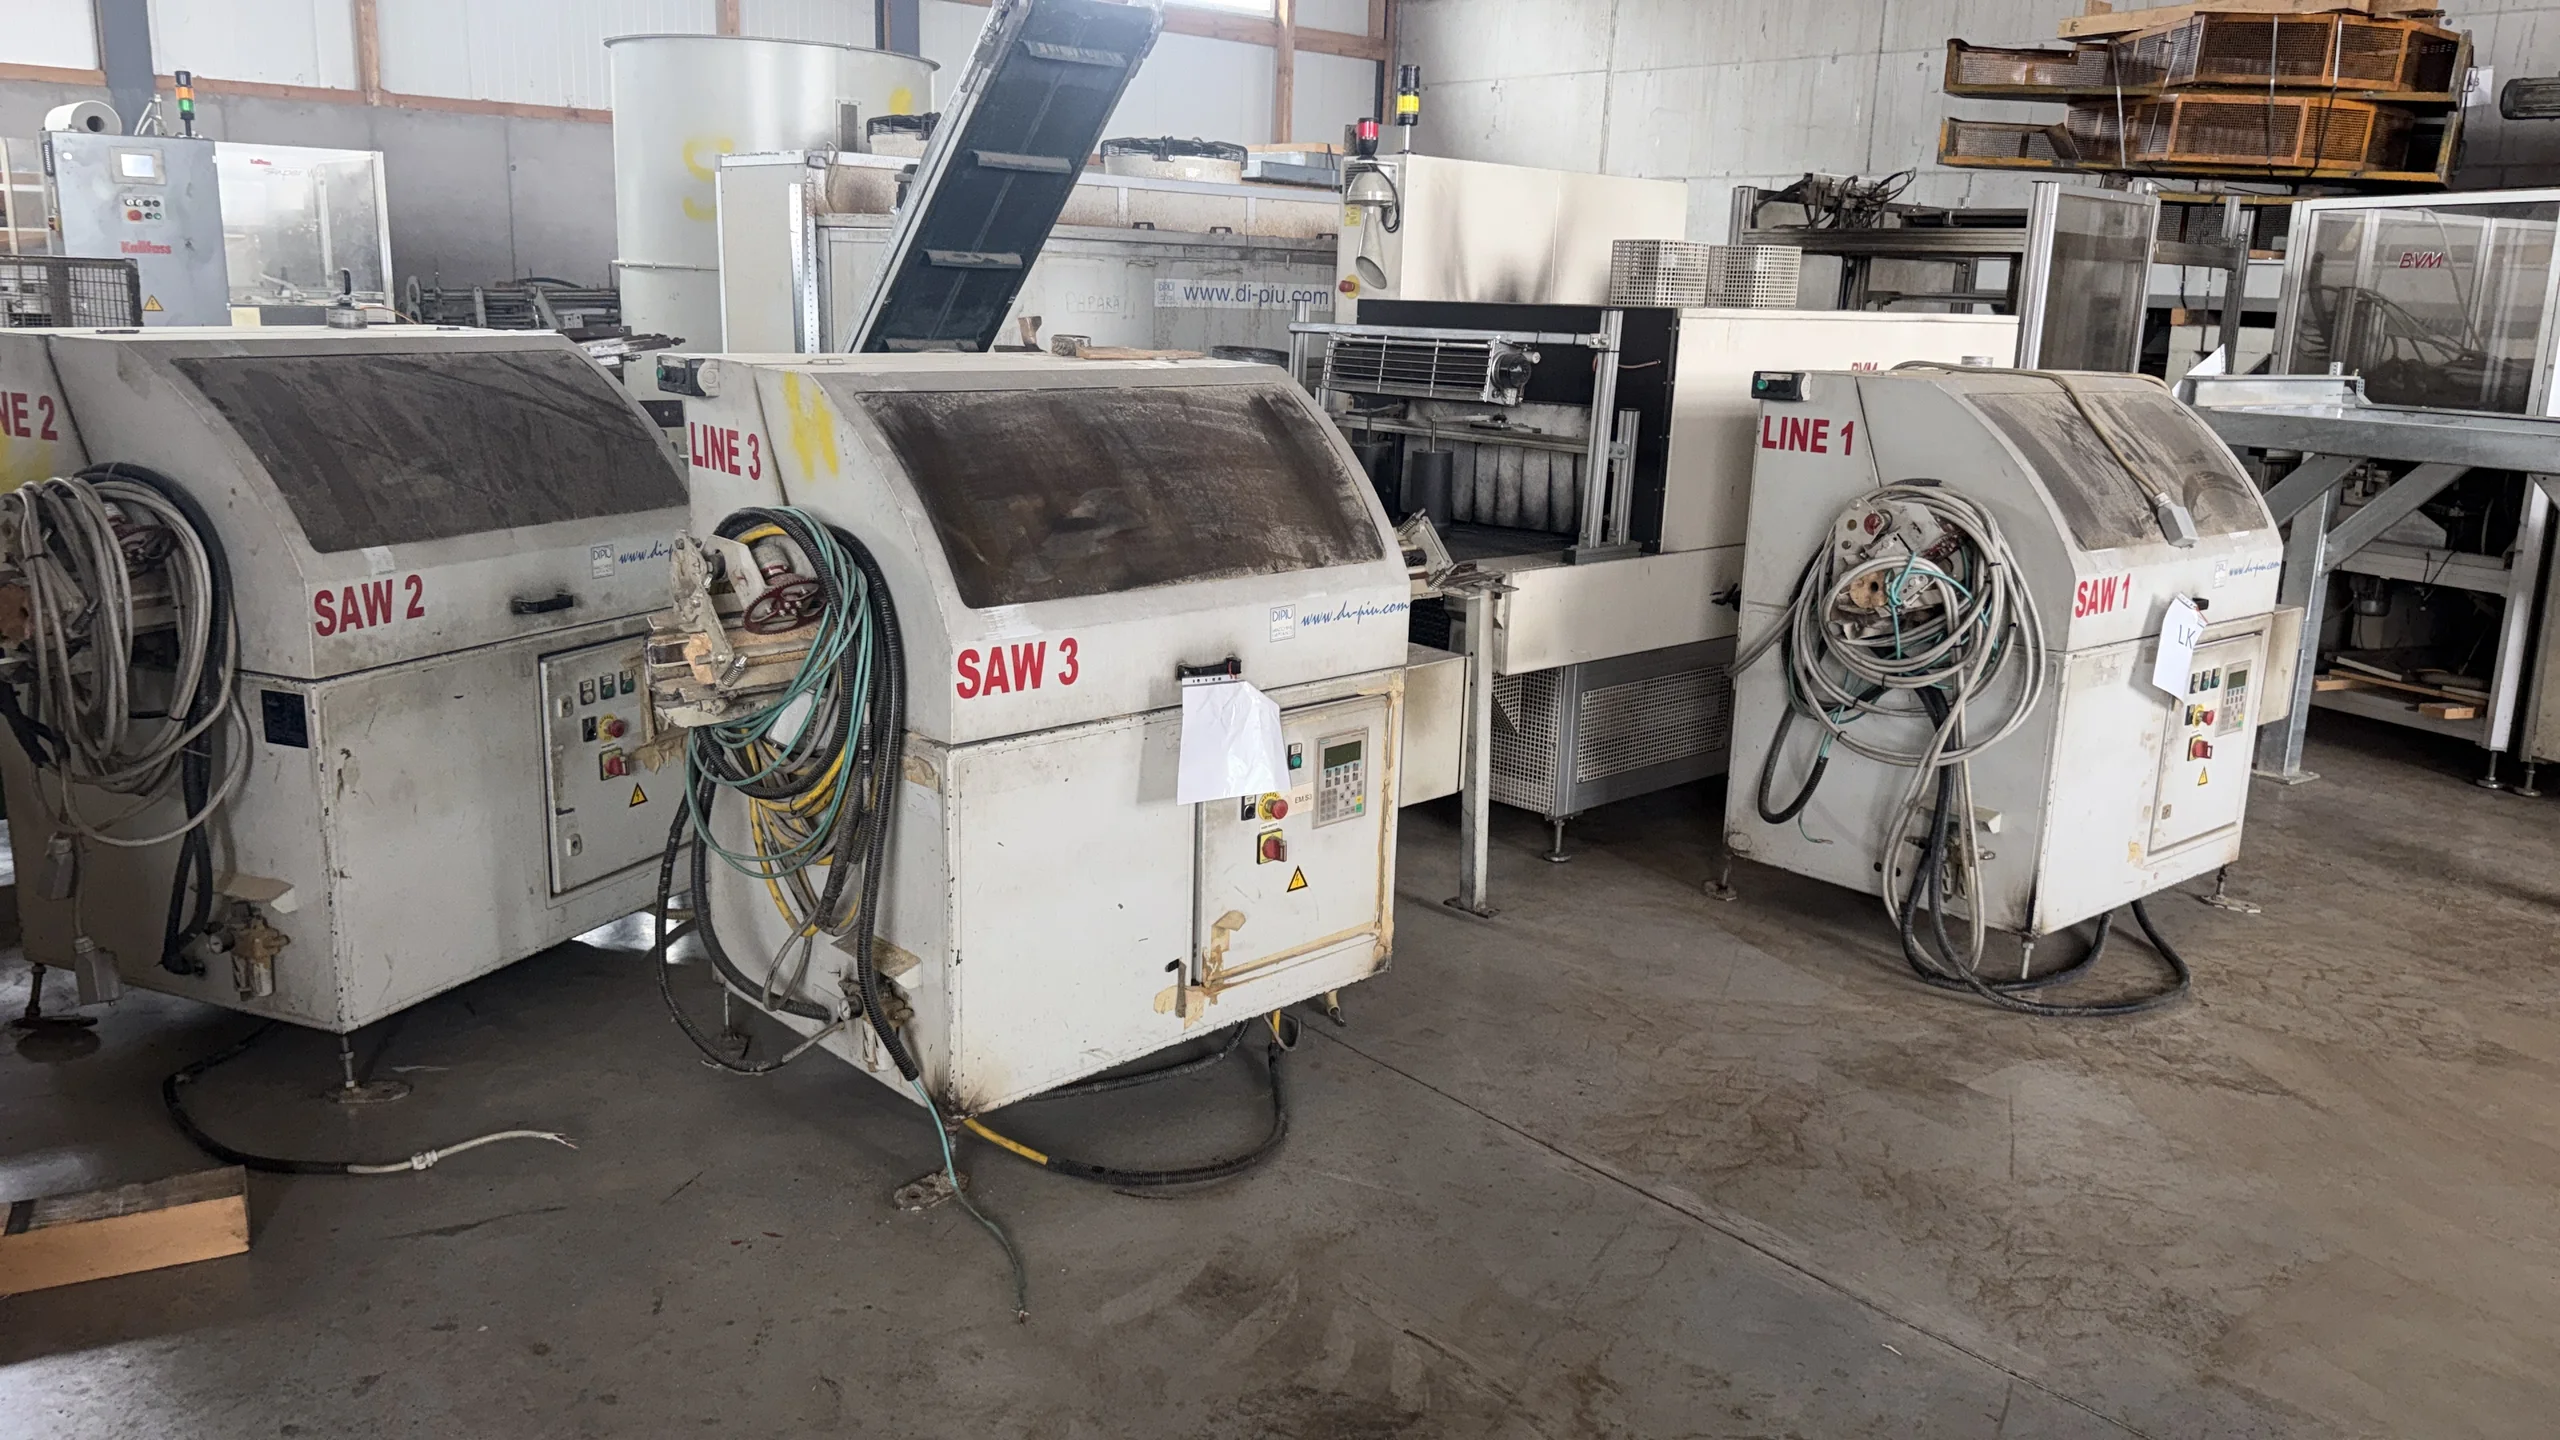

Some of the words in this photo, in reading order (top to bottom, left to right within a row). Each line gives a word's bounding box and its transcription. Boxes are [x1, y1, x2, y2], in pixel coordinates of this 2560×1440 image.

[2399, 252, 2444, 269] BVM
[1183, 284, 1328, 306] www.di-piu.com
[38, 395, 58, 441] 2
[1761, 415, 1830, 454] LINE
[1840, 421, 1855, 456] 1
[690, 422, 741, 476] LINE
[747, 433, 761, 480] 3
[315, 580, 393, 636] SAW
[406, 574, 425, 619] 2
[1301, 600, 1409, 626] www.di-piu.com
[2074, 575, 2119, 619] SAW
[2121, 573, 2131, 609] 1
[2178, 624, 2196, 650] LK
[956, 640, 1047, 700] SAW
[1058, 636, 1080, 687] 3
